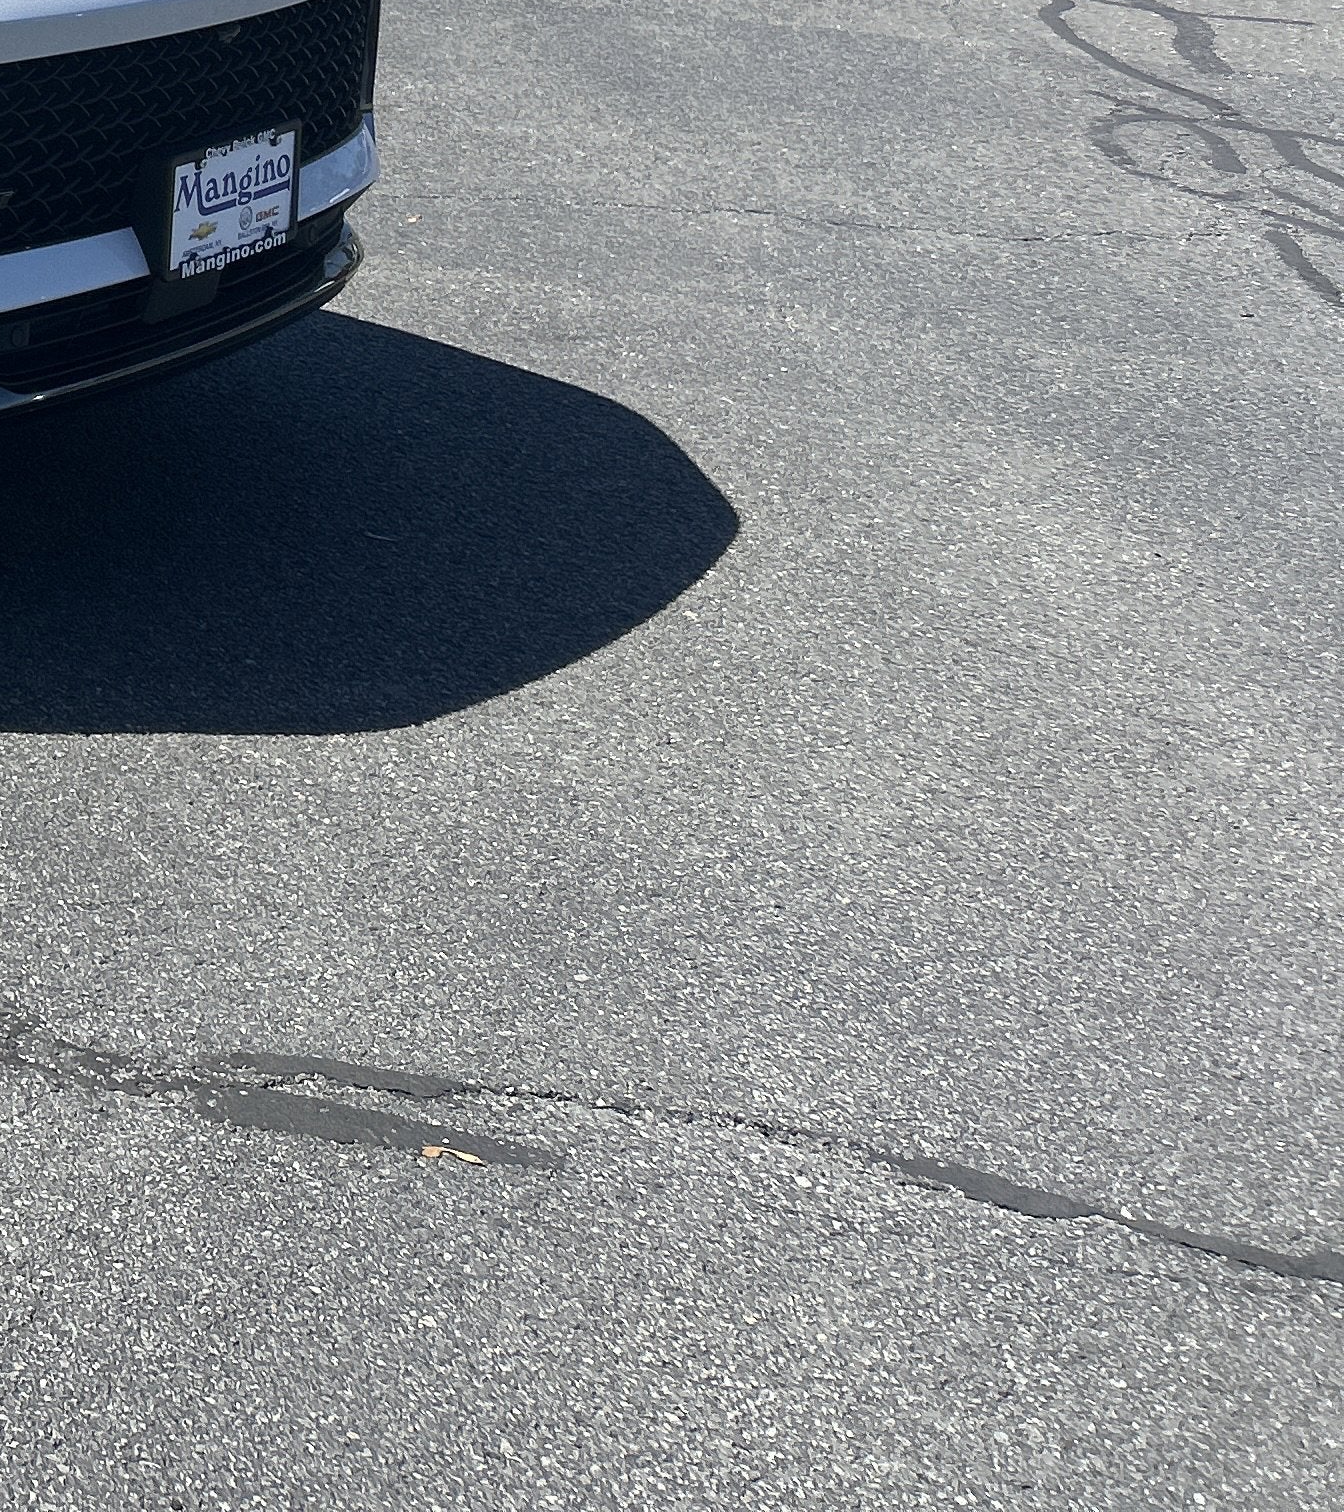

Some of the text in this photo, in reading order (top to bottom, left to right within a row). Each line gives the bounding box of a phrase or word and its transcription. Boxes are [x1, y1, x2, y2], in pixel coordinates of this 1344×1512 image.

[173, 153, 291, 216] Mangino
[255, 205, 280, 223] GMC
[181, 232, 287, 279] Mangino.com
